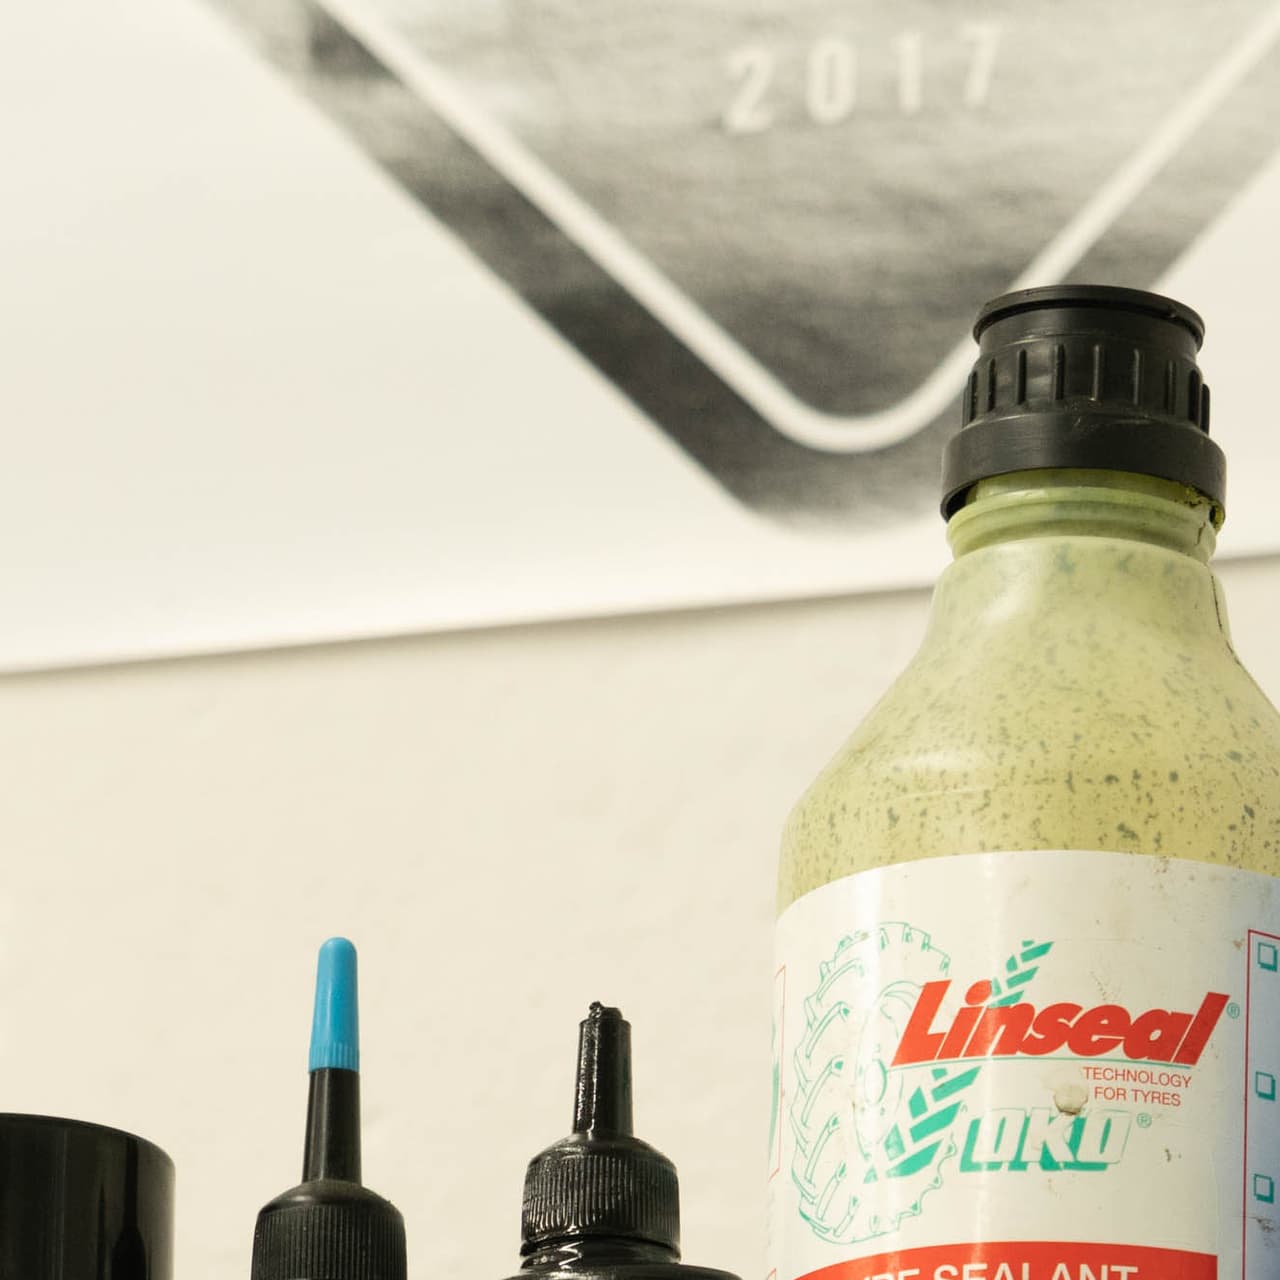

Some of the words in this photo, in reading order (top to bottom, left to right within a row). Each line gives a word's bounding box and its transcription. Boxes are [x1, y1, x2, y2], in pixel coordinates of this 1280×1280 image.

[723, 20, 1003, 133] 2017
[890, 979, 1230, 1068] Linseal
[1082, 1066, 1193, 1089] TECHNOLOGY
[1094, 1086, 1127, 1102] FOR
[1131, 1088, 1182, 1108] TYRES
